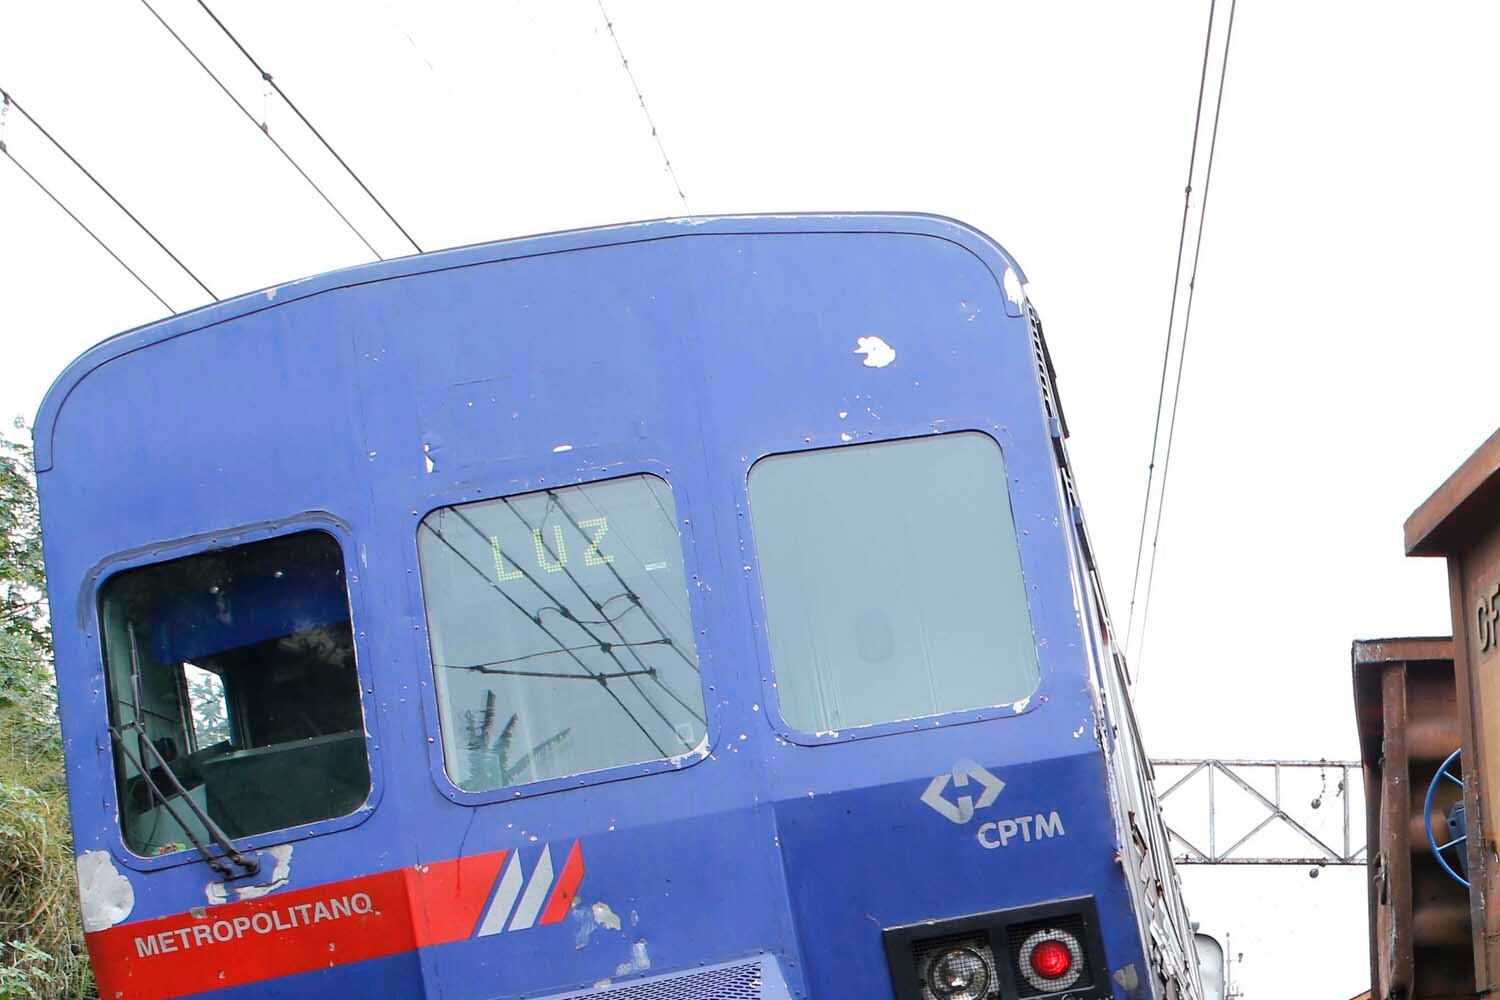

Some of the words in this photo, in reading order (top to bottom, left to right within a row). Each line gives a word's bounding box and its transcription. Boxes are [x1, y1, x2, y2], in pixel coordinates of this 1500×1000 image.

[490, 517, 614, 581] LUZ
[978, 811, 1065, 849] CPTM
[134, 892, 374, 958] METROPOLITANO
